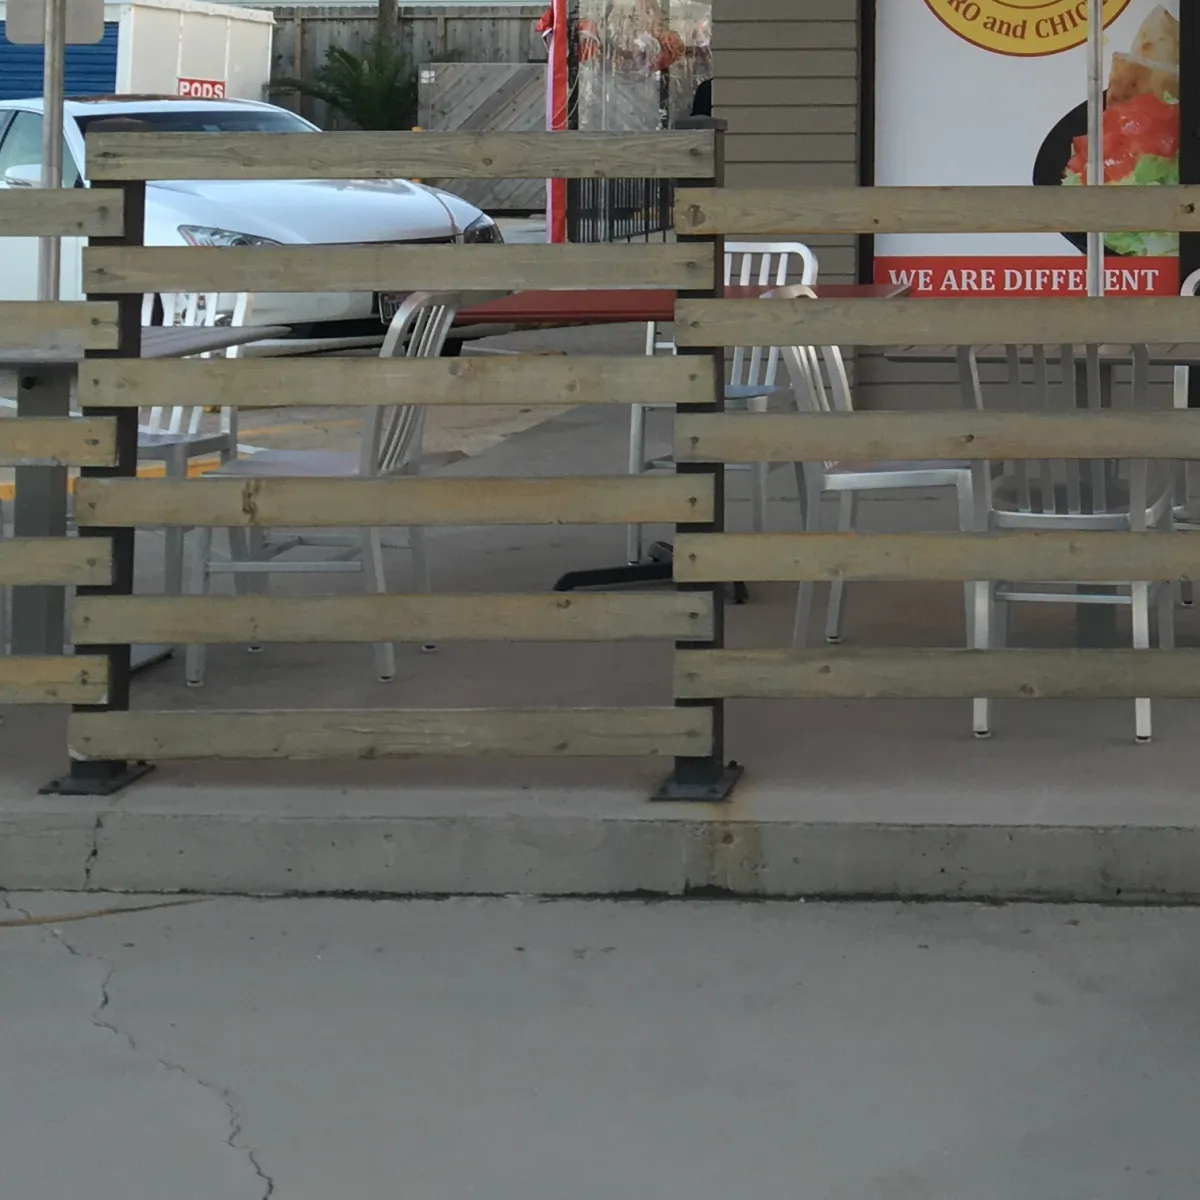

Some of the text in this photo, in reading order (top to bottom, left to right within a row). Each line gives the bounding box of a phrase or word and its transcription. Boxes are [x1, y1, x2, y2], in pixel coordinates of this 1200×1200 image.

[983, 15, 1027, 40] and
[180, 81, 224, 98] PODS
[888, 269, 1159, 291] WE ARE DIFFEENT
